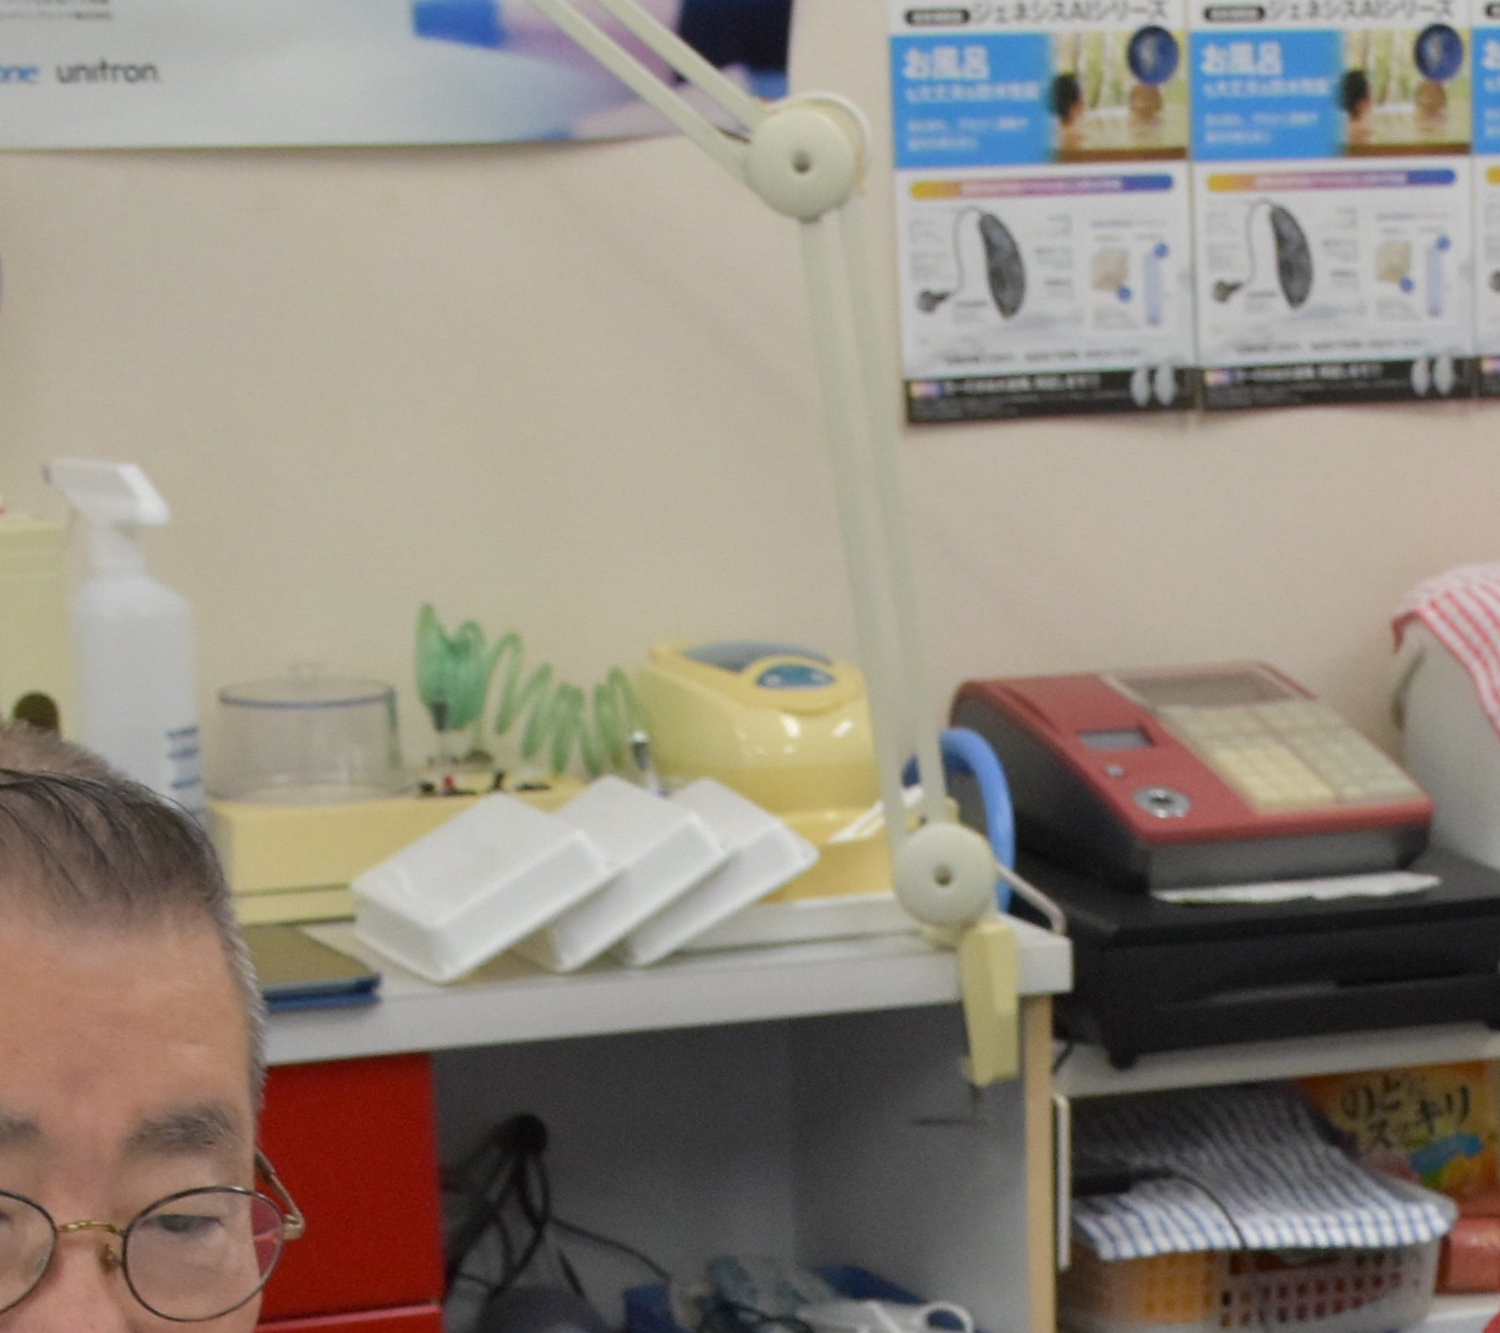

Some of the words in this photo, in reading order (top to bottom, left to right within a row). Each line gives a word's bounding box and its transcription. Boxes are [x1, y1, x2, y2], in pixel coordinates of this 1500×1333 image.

[903, 48, 990, 78] お風呂
[1201, 44, 1283, 75] お風呂
